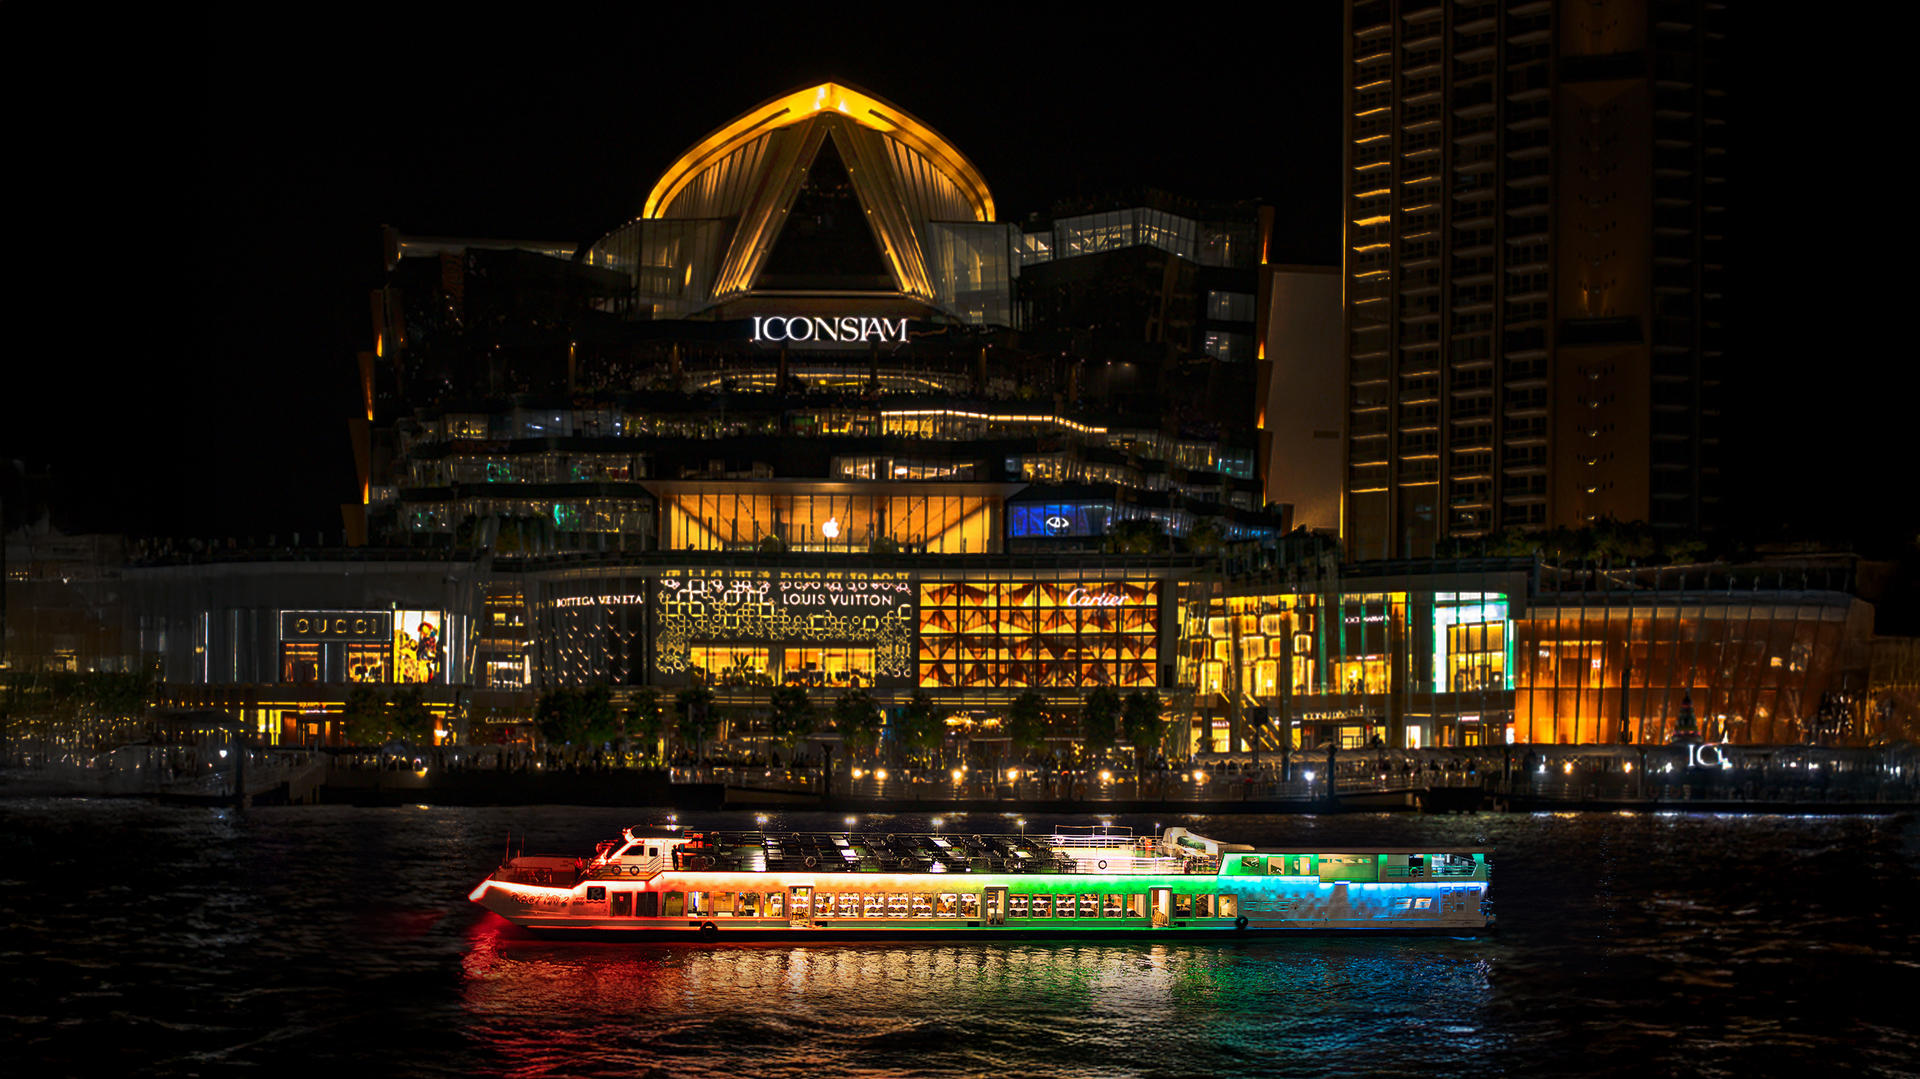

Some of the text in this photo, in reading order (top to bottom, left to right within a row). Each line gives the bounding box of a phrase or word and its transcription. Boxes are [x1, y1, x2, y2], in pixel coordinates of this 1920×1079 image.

[753, 315, 909, 342] ICONSIAM
[556, 594, 643, 608] BOTTEGA VENETA
[783, 593, 892, 606] LOUIS VUITTON
[1067, 588, 1129, 606] Cartier
[295, 618, 376, 634] GUCCI
